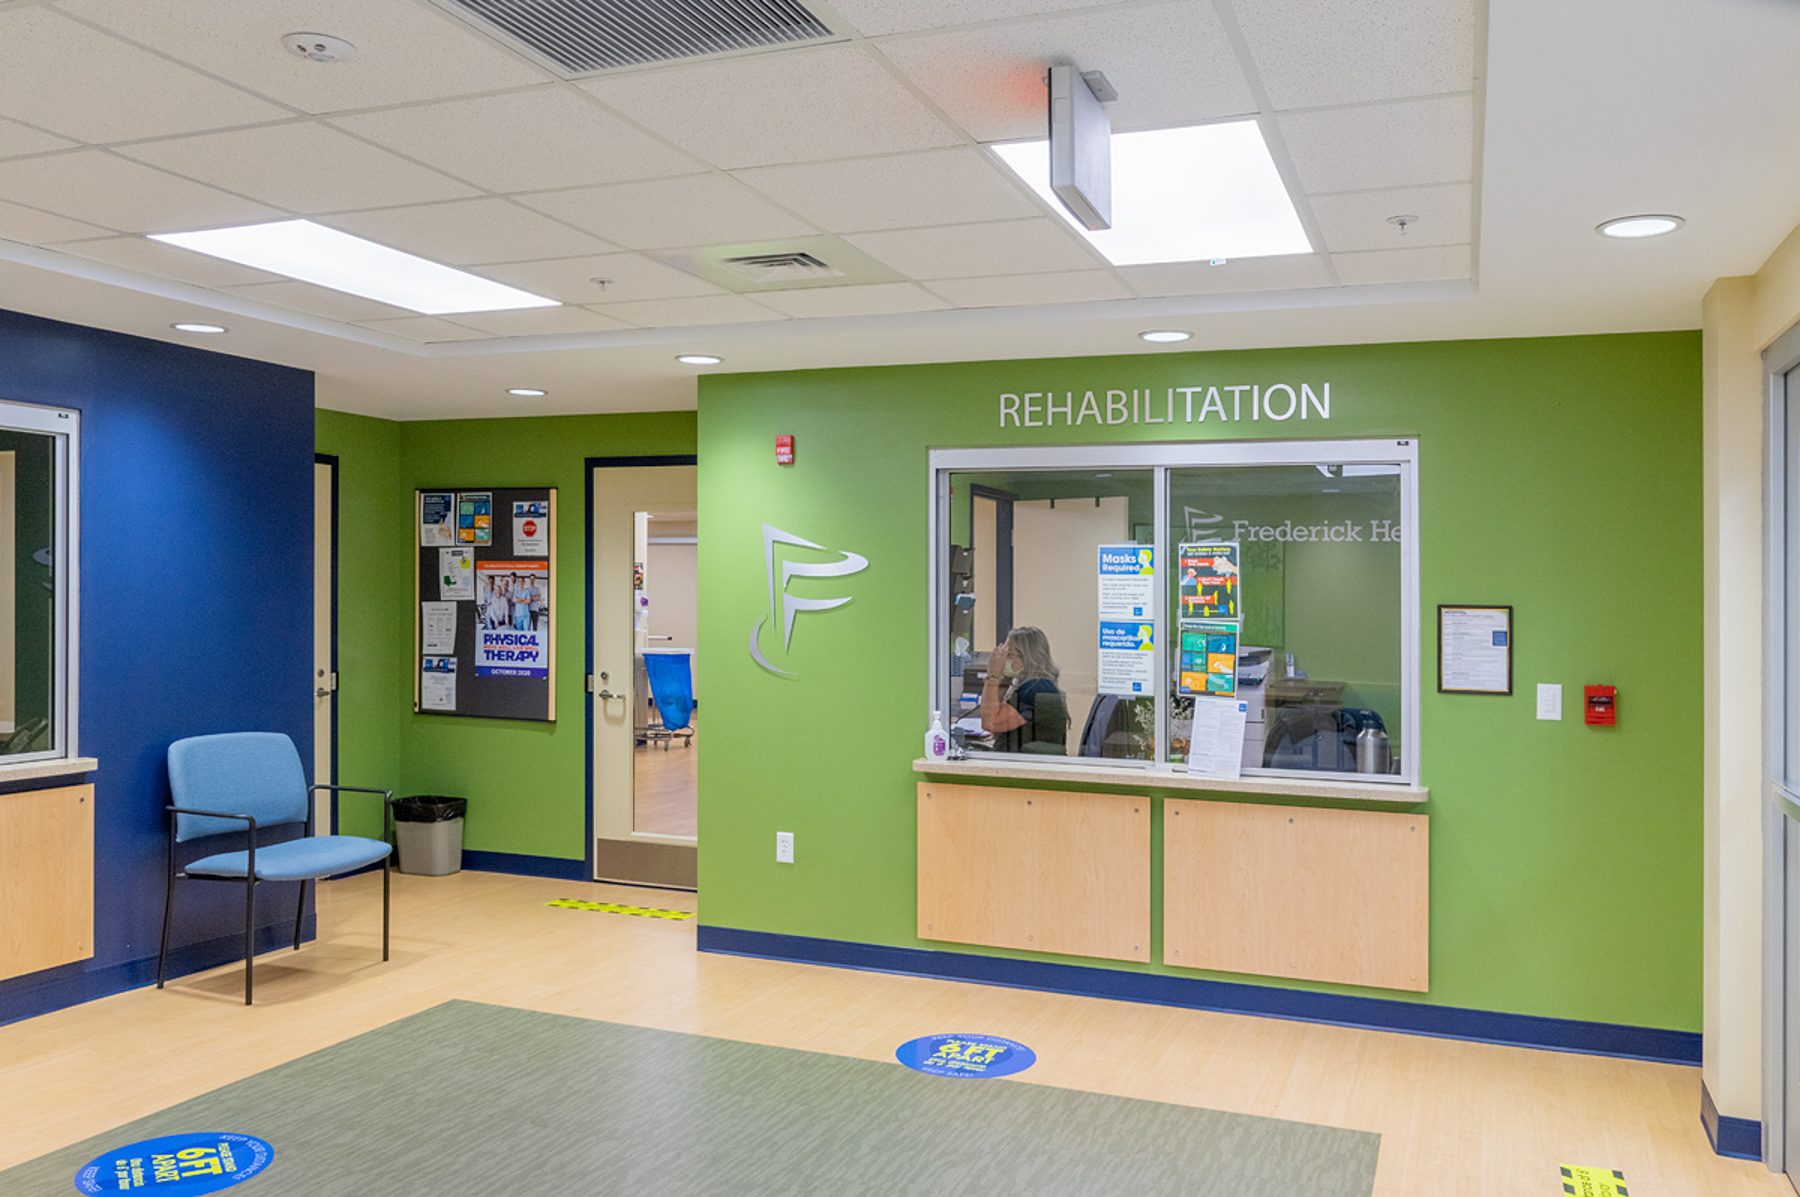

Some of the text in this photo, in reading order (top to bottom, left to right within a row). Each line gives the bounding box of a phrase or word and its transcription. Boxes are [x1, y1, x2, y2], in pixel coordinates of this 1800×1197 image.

[999, 382, 1331, 428] REHABILITATION
[1232, 519, 1363, 543] Frederick
[1102, 553, 1137, 563] Masks
[483, 634, 539, 646] PHYSICAL
[483, 650, 539, 662] THERAPY
[932, 1051, 995, 1064] APART
[151, 1154, 180, 1183] APART
